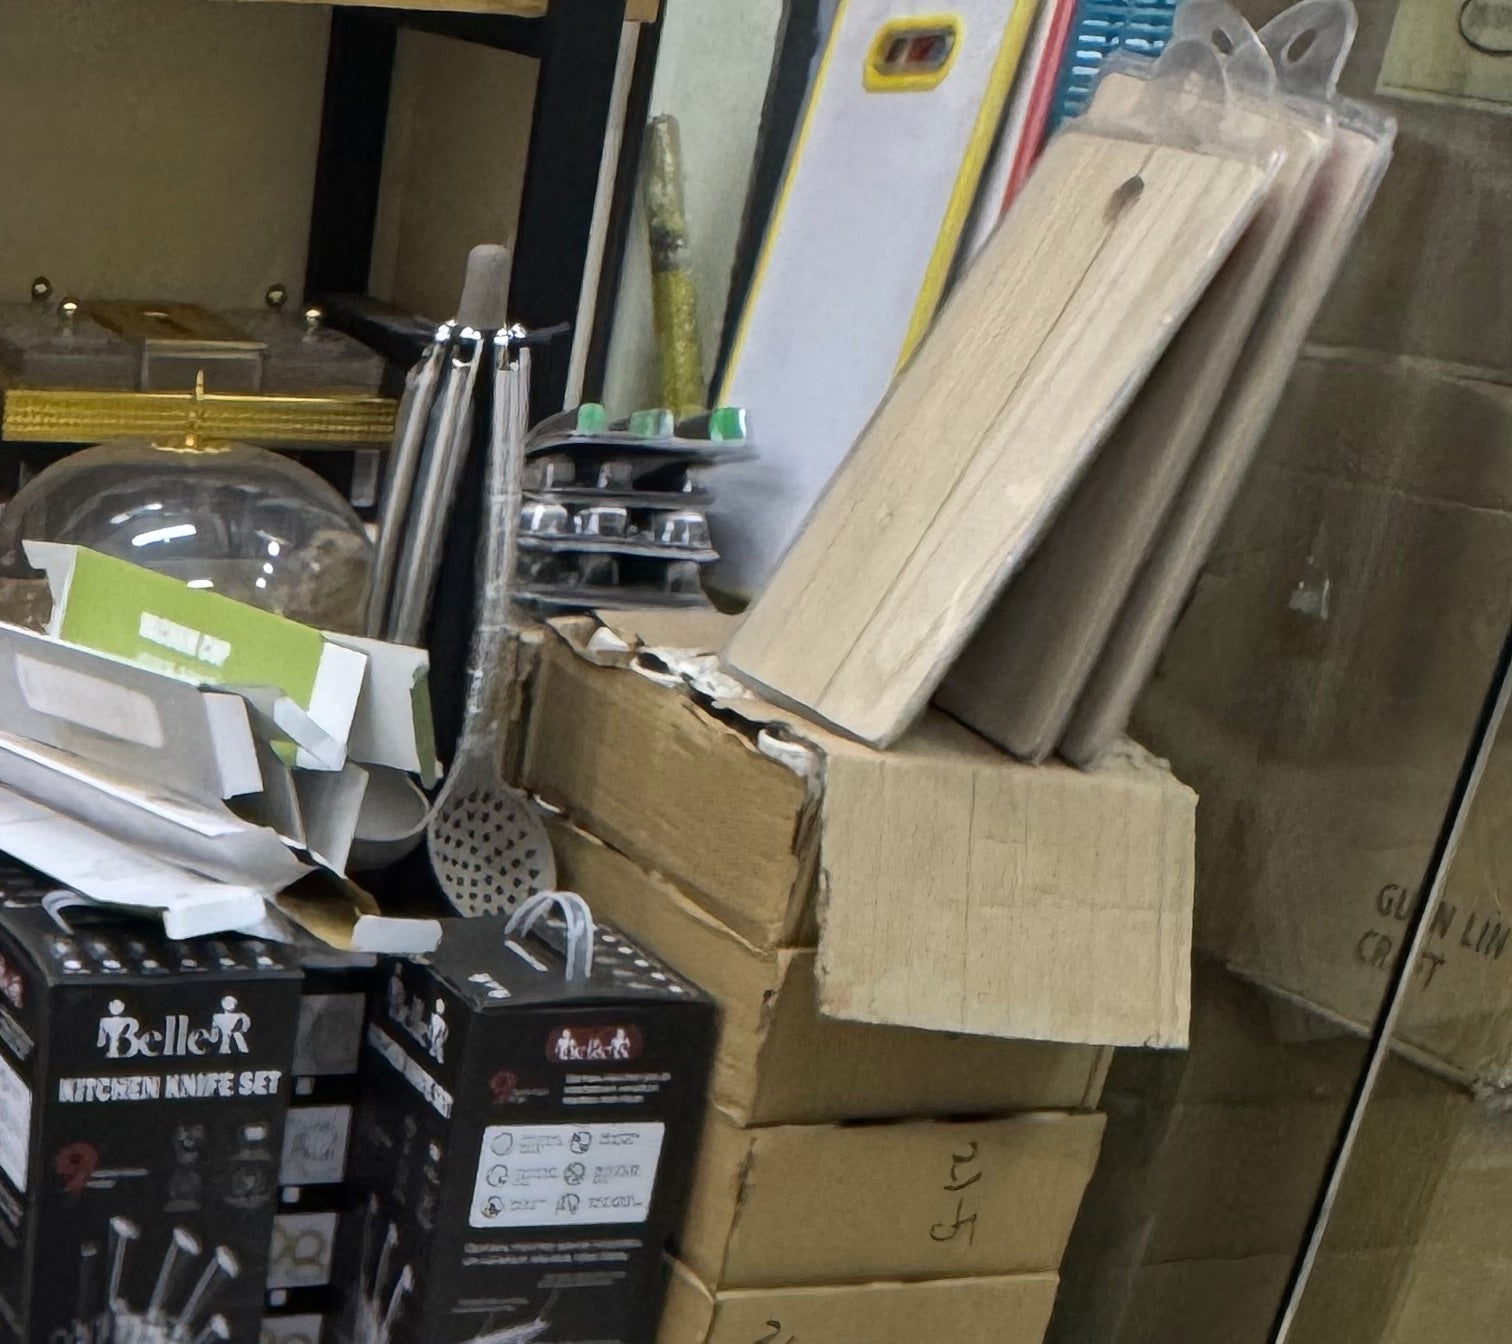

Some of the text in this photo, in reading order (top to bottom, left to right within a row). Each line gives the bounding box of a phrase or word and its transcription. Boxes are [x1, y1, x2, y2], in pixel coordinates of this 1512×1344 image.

[58, 1070, 283, 1102] KITCHEN KNIFE SET
